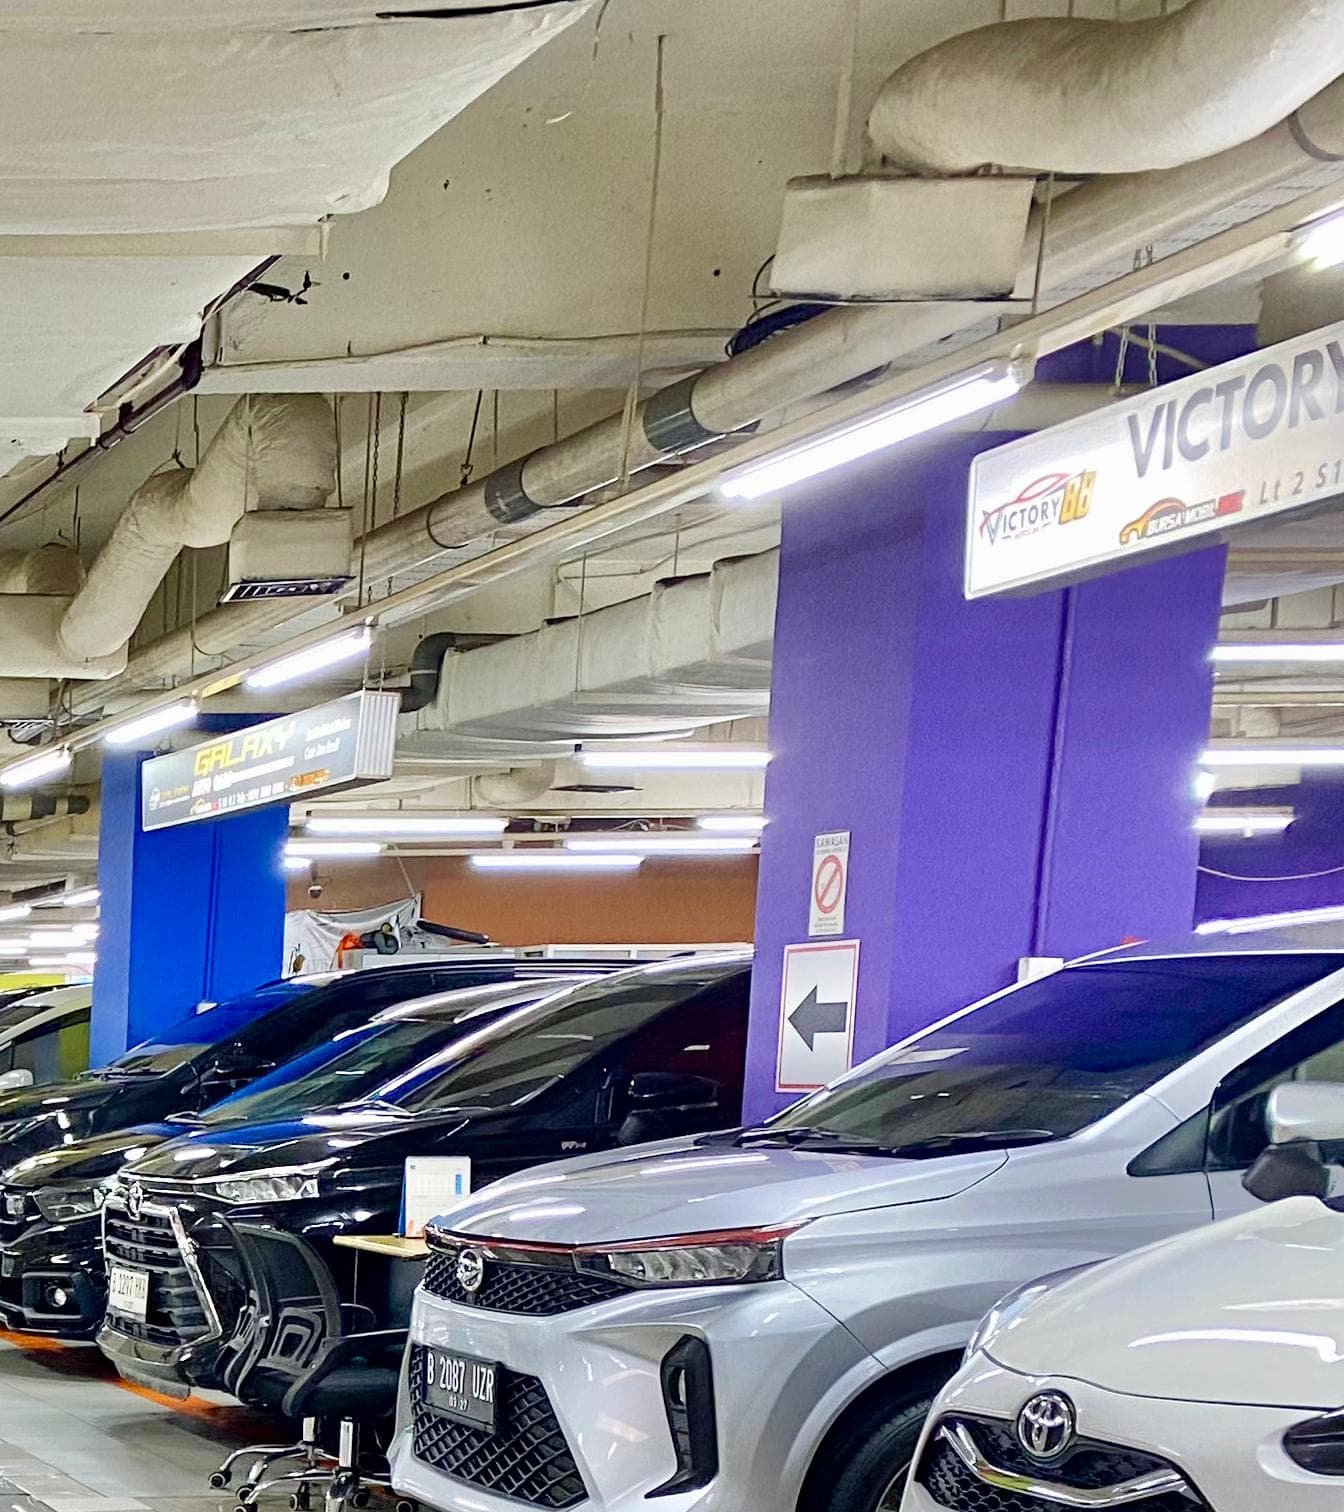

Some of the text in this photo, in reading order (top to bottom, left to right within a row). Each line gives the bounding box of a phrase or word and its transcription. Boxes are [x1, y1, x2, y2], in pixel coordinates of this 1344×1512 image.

[981, 497, 1060, 546] VICTORY
[193, 722, 296, 776] GALAXY
[426, 1352, 494, 1403] B 2087 UZR
